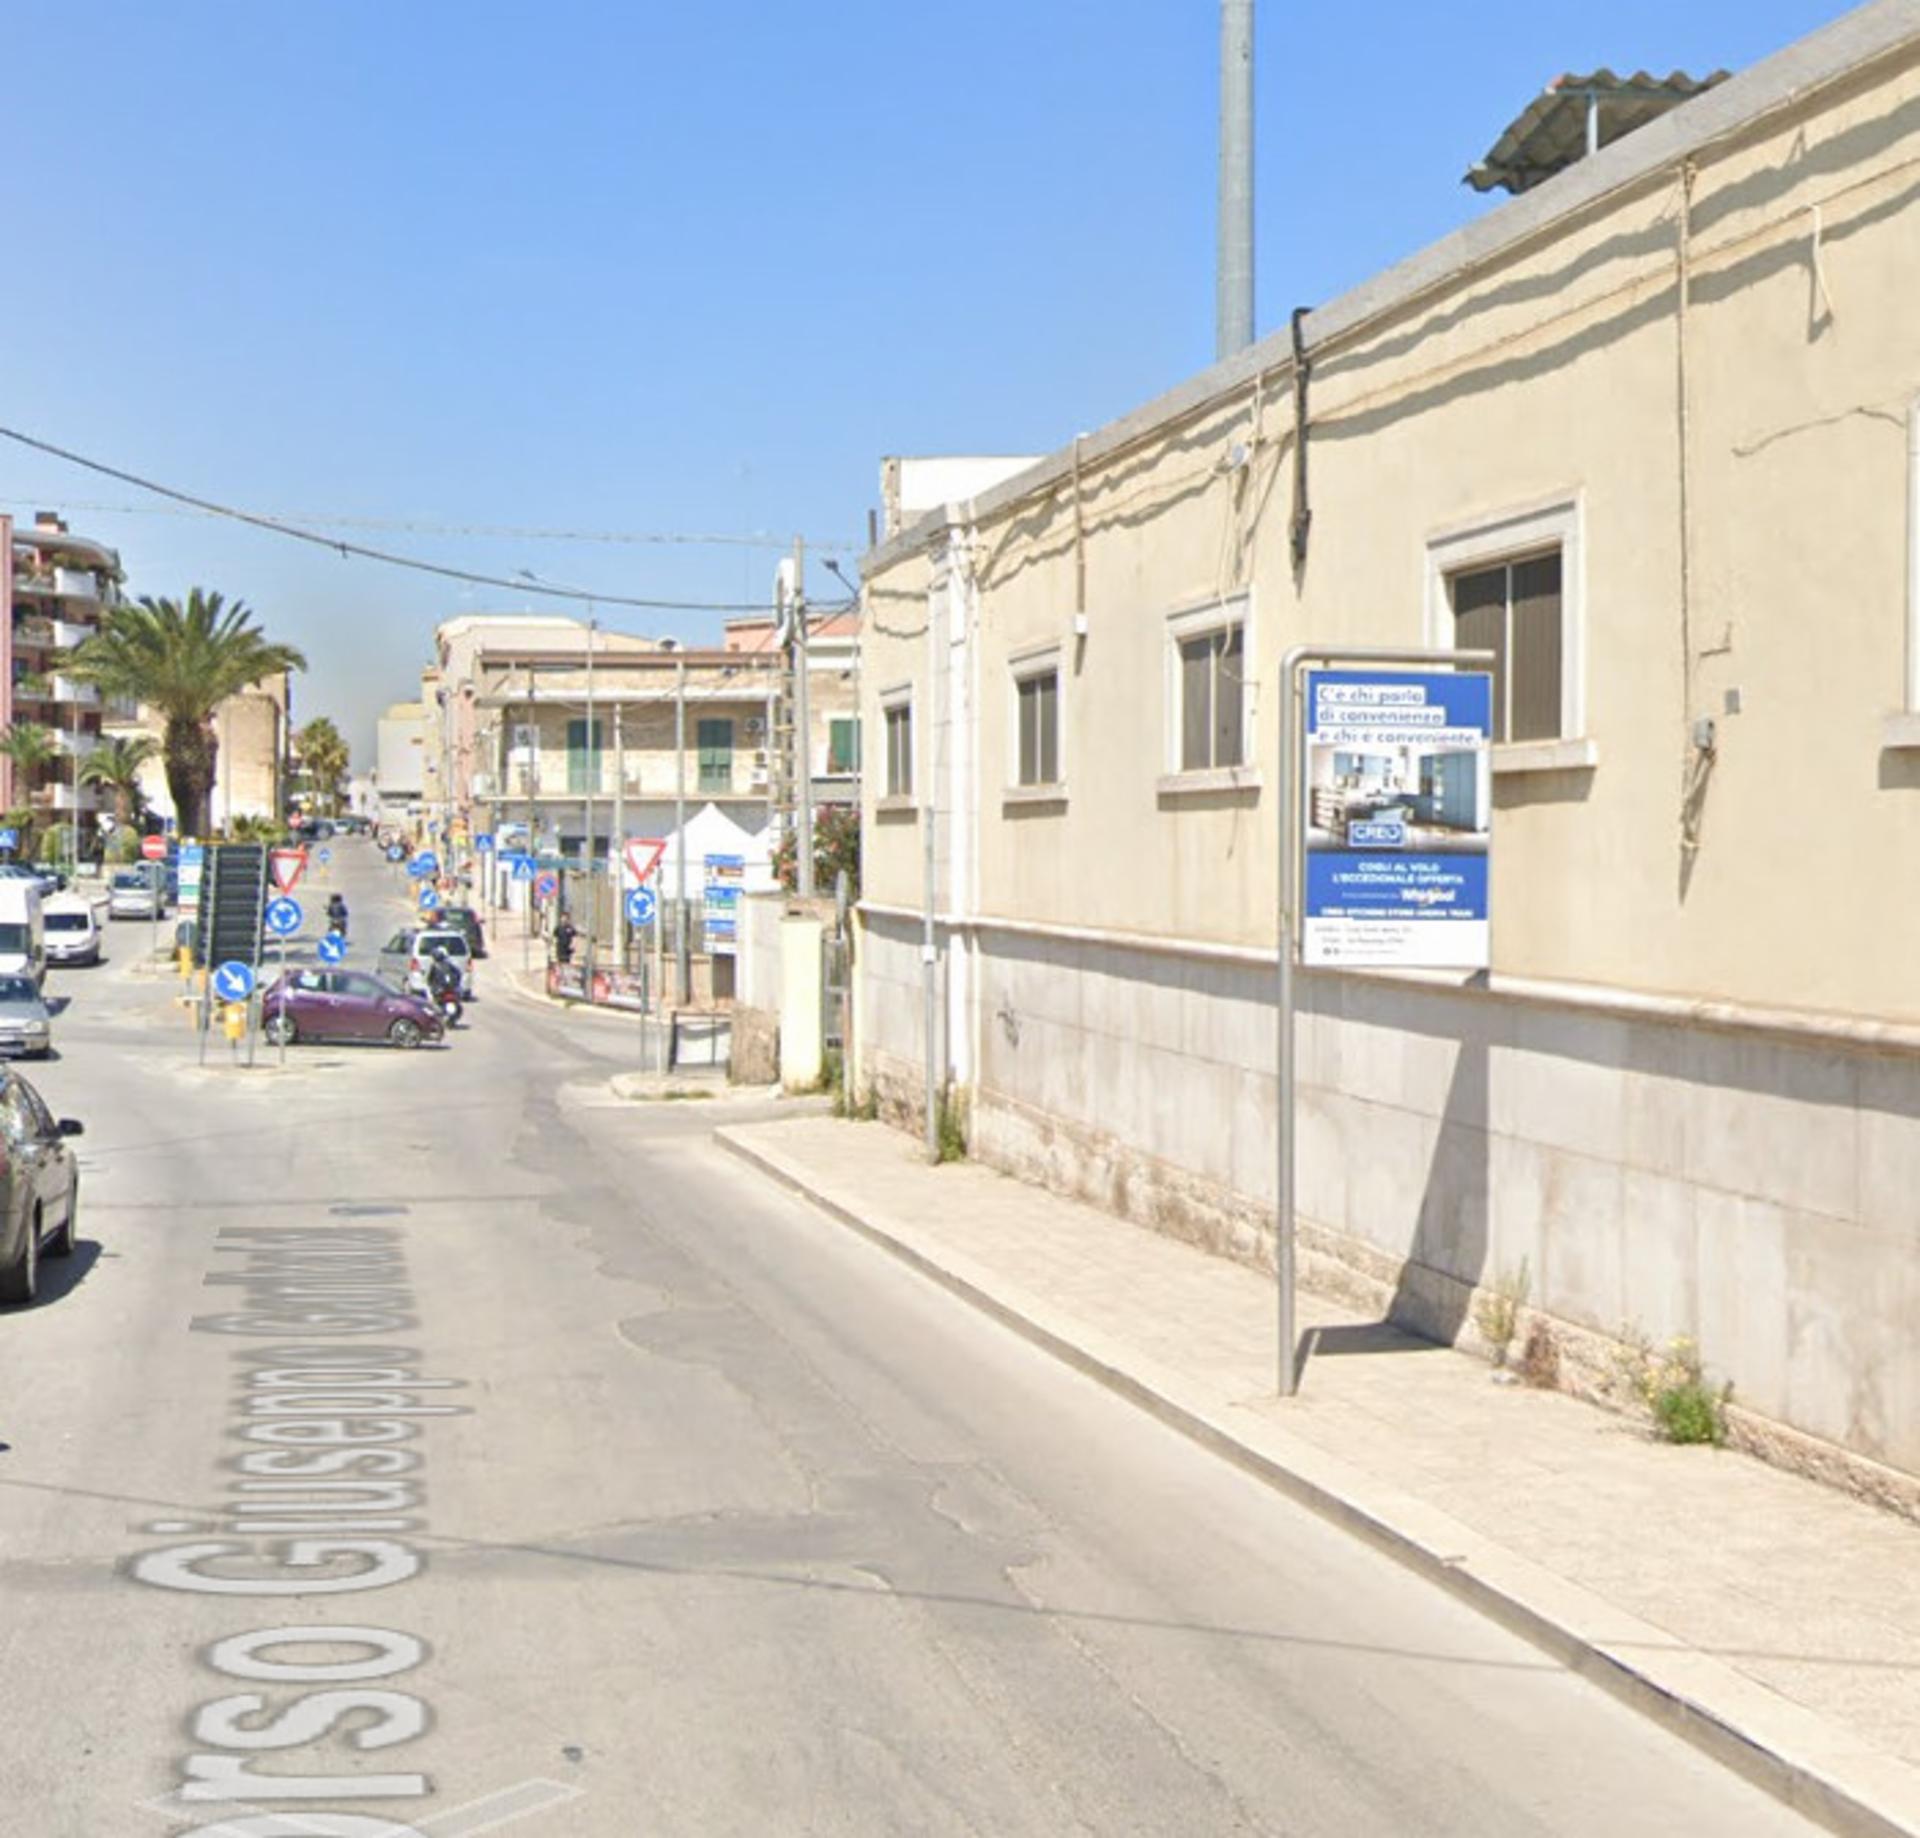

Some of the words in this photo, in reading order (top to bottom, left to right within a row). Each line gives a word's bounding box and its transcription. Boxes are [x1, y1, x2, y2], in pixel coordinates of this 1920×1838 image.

[1350, 687, 1374, 701] chi
[1379, 688, 1423, 704] parla
[1319, 706, 1335, 720] di
[1339, 710, 1443, 723] convenienza
[1333, 729, 1357, 742] chi
[1393, 862, 1408, 873] AL
[1410, 862, 1440, 873] VOLO
[1417, 874, 1465, 885] OFFERTA
